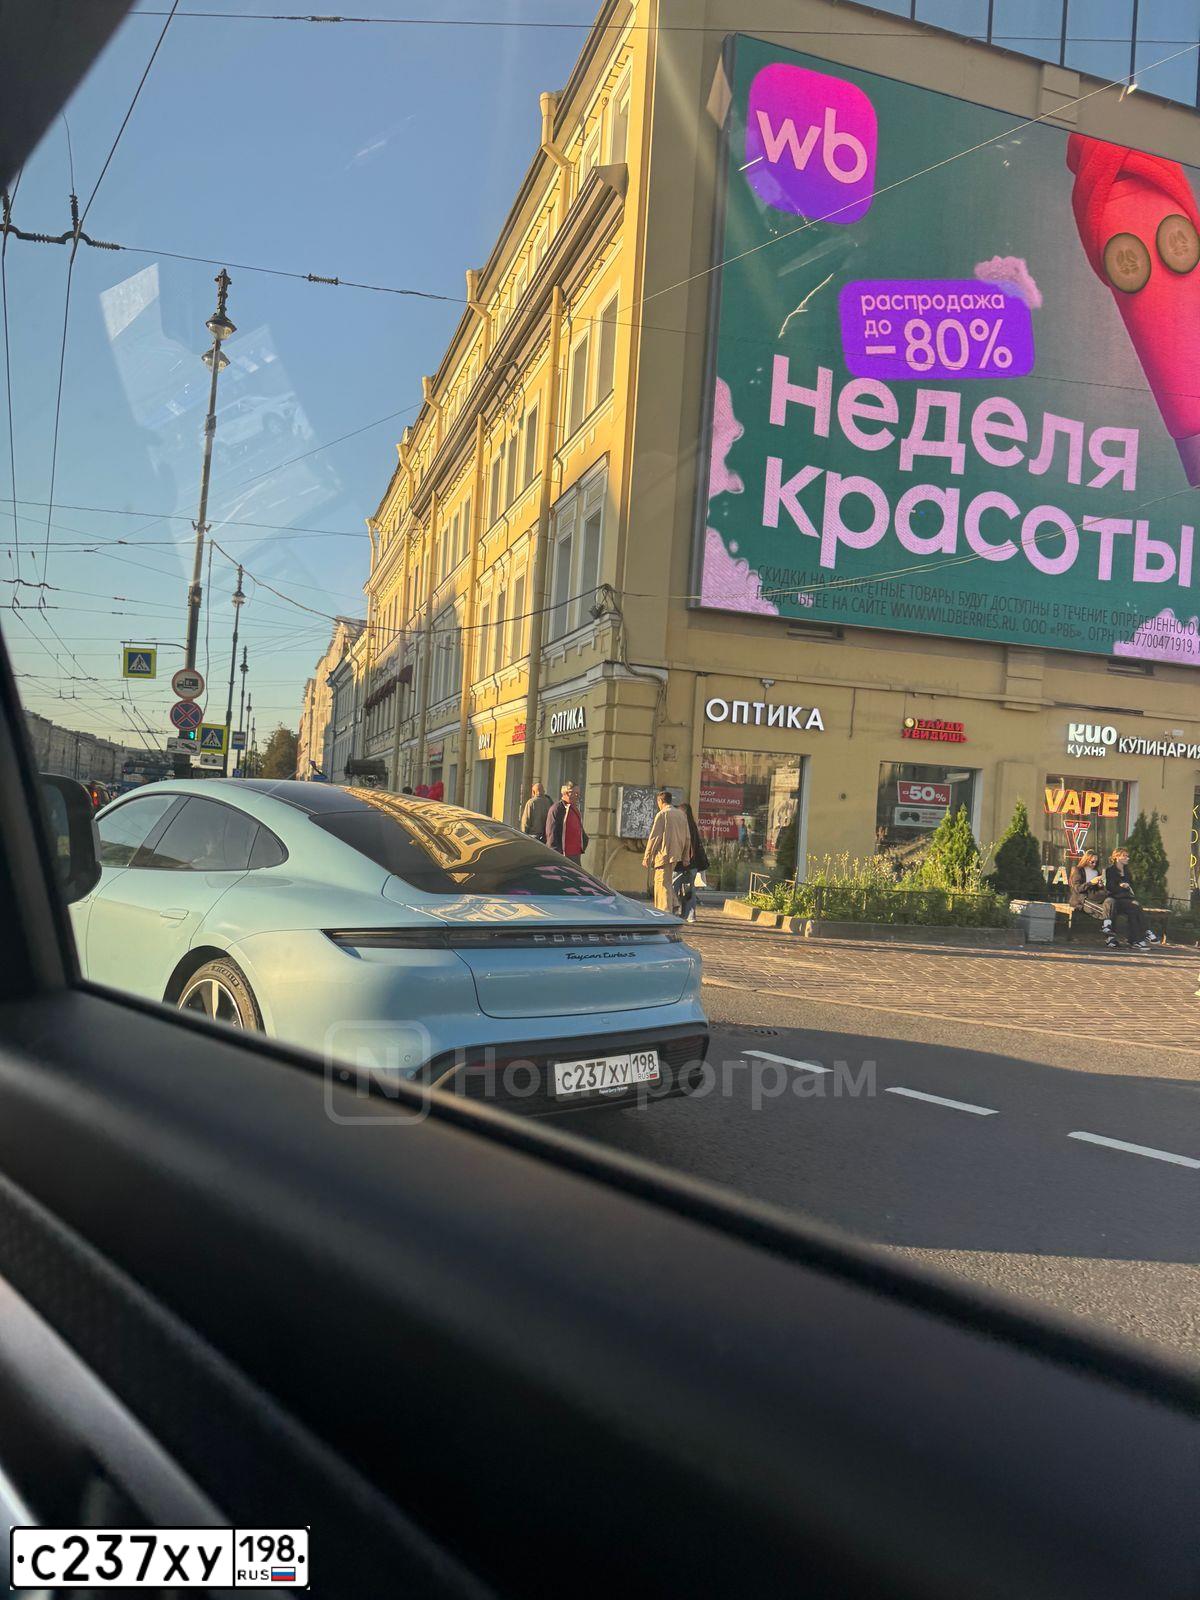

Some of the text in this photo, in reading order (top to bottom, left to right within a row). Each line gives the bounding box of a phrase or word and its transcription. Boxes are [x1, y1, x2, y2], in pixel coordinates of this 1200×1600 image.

[756, 106, 868, 184] wb
[860, 291, 1005, 315] распродажа
[864, 318, 892, 338] до
[762, 456, 1195, 587] красоты
[758, 565, 806, 586] СКИДКИ
[811, 572, 826, 587] НА
[906, 585, 955, 605] ТОВАРЫ
[959, 591, 988, 611] БУДУТ
[991, 595, 1050, 618] ДОСТУПНЫ
[1052, 603, 1060, 618] В
[1062, 605, 1109, 625] ТЕЧЕНИЕ
[1112, 611, 1196, 636] ОПРЕДЕЛЕННОГО
[757, 585, 829, 609] ПОДРОБНЕЕ
[832, 595, 848, 610] НА
[852, 592, 887, 617] САЙТЕ
[1088, 627, 1115, 641] ОГРН
[550, 706, 586, 734] ОПТИКА
[705, 697, 826, 732] ОПТИКА
[919, 719, 965, 731] ЗАЙДИ
[902, 729, 968, 743] УВИДИШЬ
[902, 786, 947, 802] -50%
[1044, 787, 1120, 817] VAPE
[533, 933, 642, 942] PORSCHE
[565, 952, 602, 961] Taycan
[632, 1053, 655, 1074] 198
